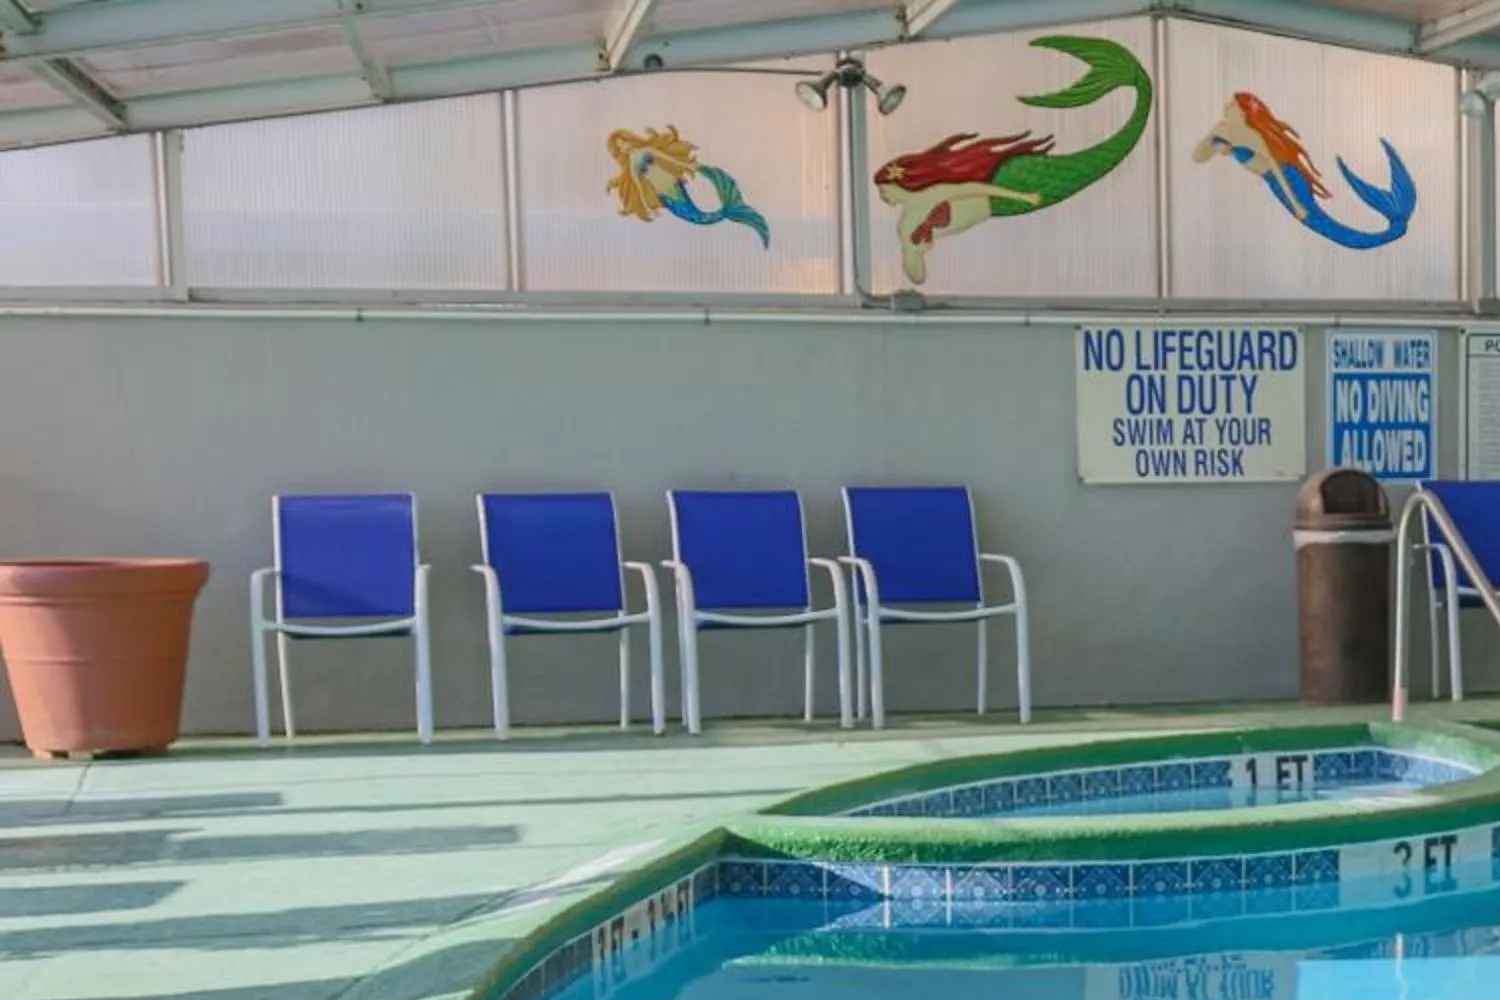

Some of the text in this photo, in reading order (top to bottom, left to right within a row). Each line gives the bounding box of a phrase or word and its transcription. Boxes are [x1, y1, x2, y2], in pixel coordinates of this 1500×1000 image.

[1083, 328, 1298, 372] NO LIFEGUARD
[1334, 339, 1430, 369] SHALLOW WATER
[1126, 373, 1258, 415] ON DUTY
[1336, 379, 1430, 424] NO DIVING
[1112, 418, 1272, 446] SWIM AT YOUR
[1340, 429, 1427, 473] ALLOWED
[1135, 449, 1245, 477] OWN RISK
[1245, 754, 1309, 790] 1 FT
[1423, 834, 1459, 875] FT
